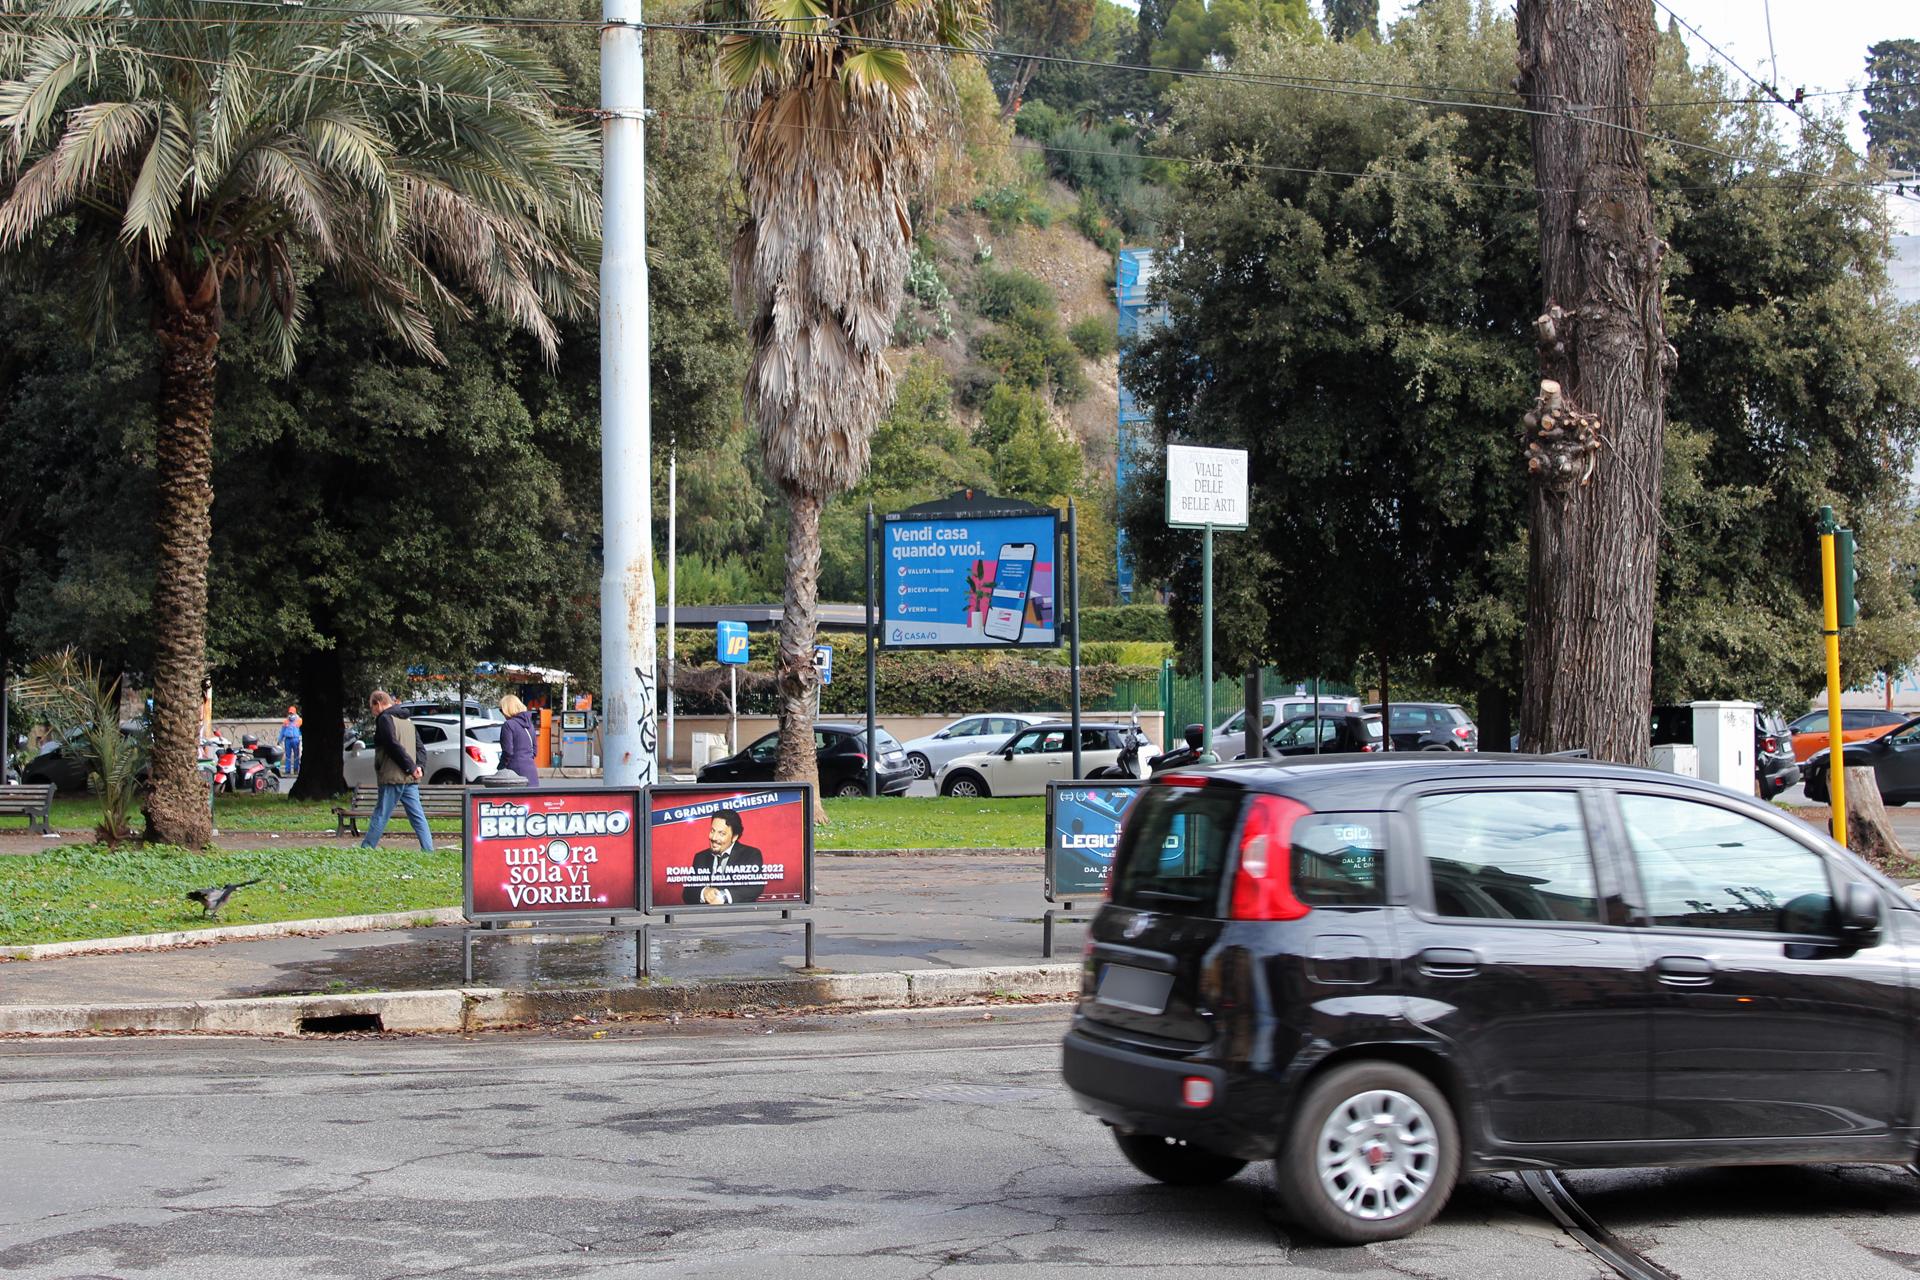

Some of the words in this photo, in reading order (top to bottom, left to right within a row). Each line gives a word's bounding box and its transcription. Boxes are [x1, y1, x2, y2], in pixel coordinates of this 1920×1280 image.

[1195, 462, 1223, 477] VIALE
[1194, 479, 1223, 493] DELLE
[1181, 496, 1210, 511] BELLE
[1214, 498, 1235, 512] ARTI
[892, 526, 932, 541] Vendi
[936, 528, 968, 540] casa
[892, 542, 946, 560] quando
[950, 541, 985, 556] vuoi.
[480, 803, 526, 816] Enrico
[664, 812, 672, 821] A
[674, 803, 720, 819] GRANDE
[722, 793, 778, 810] RICHIESTA!
[480, 812, 630, 838] BRIGNANO
[510, 858, 563, 884] sola
[666, 866, 695, 875] ROMA
[725, 865, 760, 874] MARZO
[762, 864, 784, 872] 2022
[666, 875, 710, 883] AUDITORIUM
[711, 874, 732, 882] DELLA
[732, 873, 784, 881] CONCILIAZIONE
